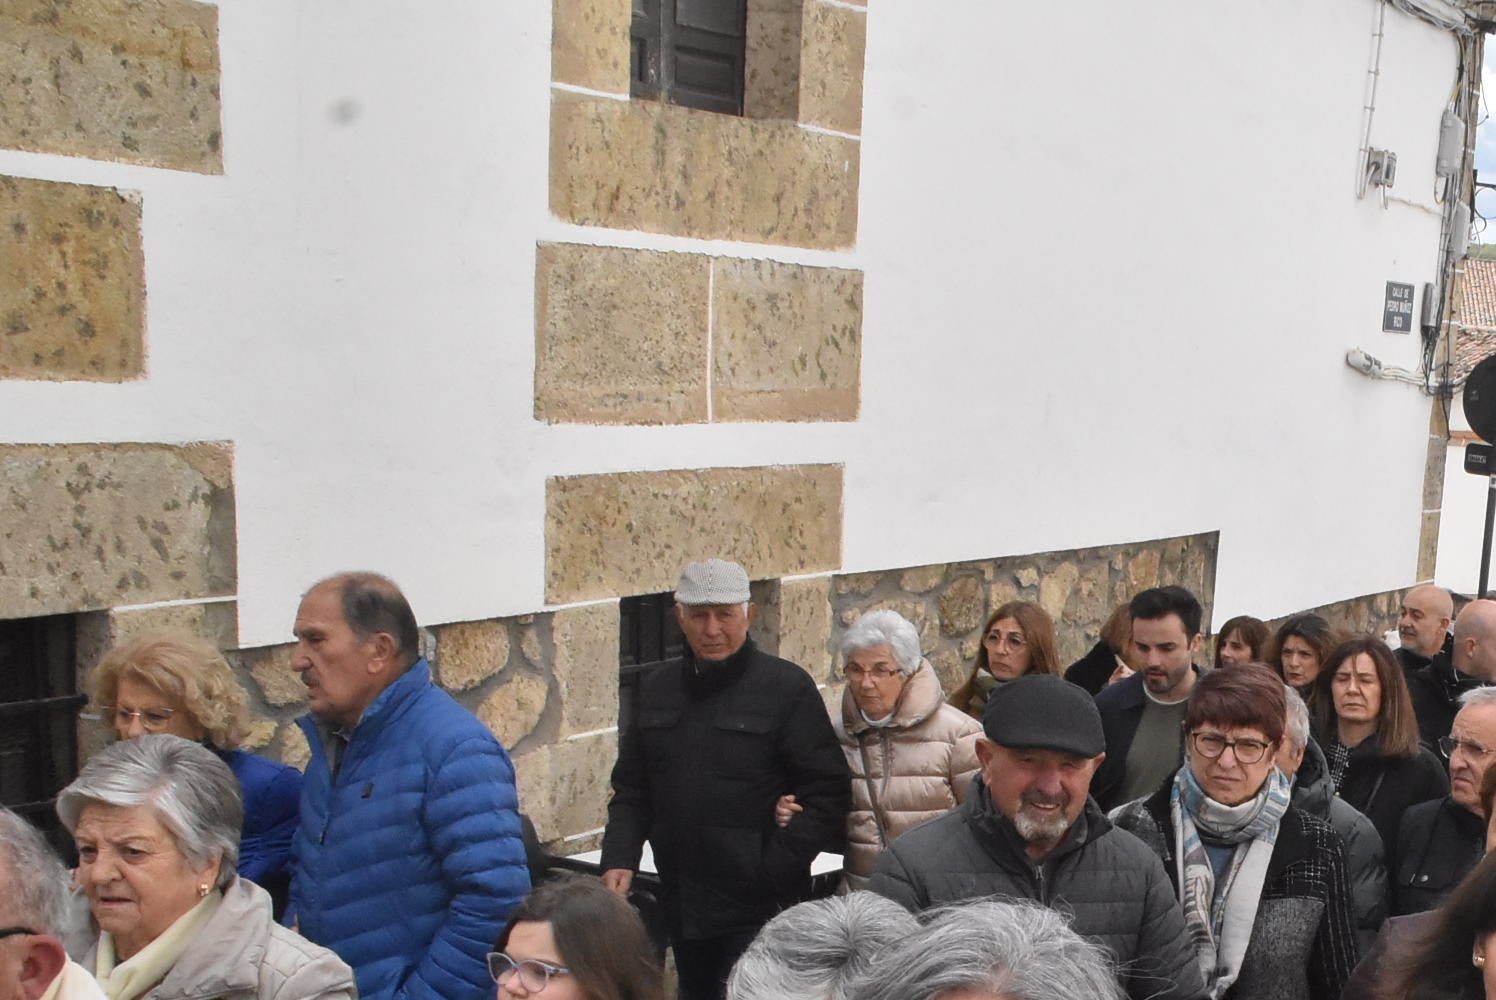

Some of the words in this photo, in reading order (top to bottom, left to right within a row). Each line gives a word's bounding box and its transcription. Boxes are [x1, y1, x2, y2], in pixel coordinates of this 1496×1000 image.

[1392, 287, 1403, 298] CALLE
[1404, 288, 1409, 299] DE
[1387, 300, 1399, 312] PEDRO
